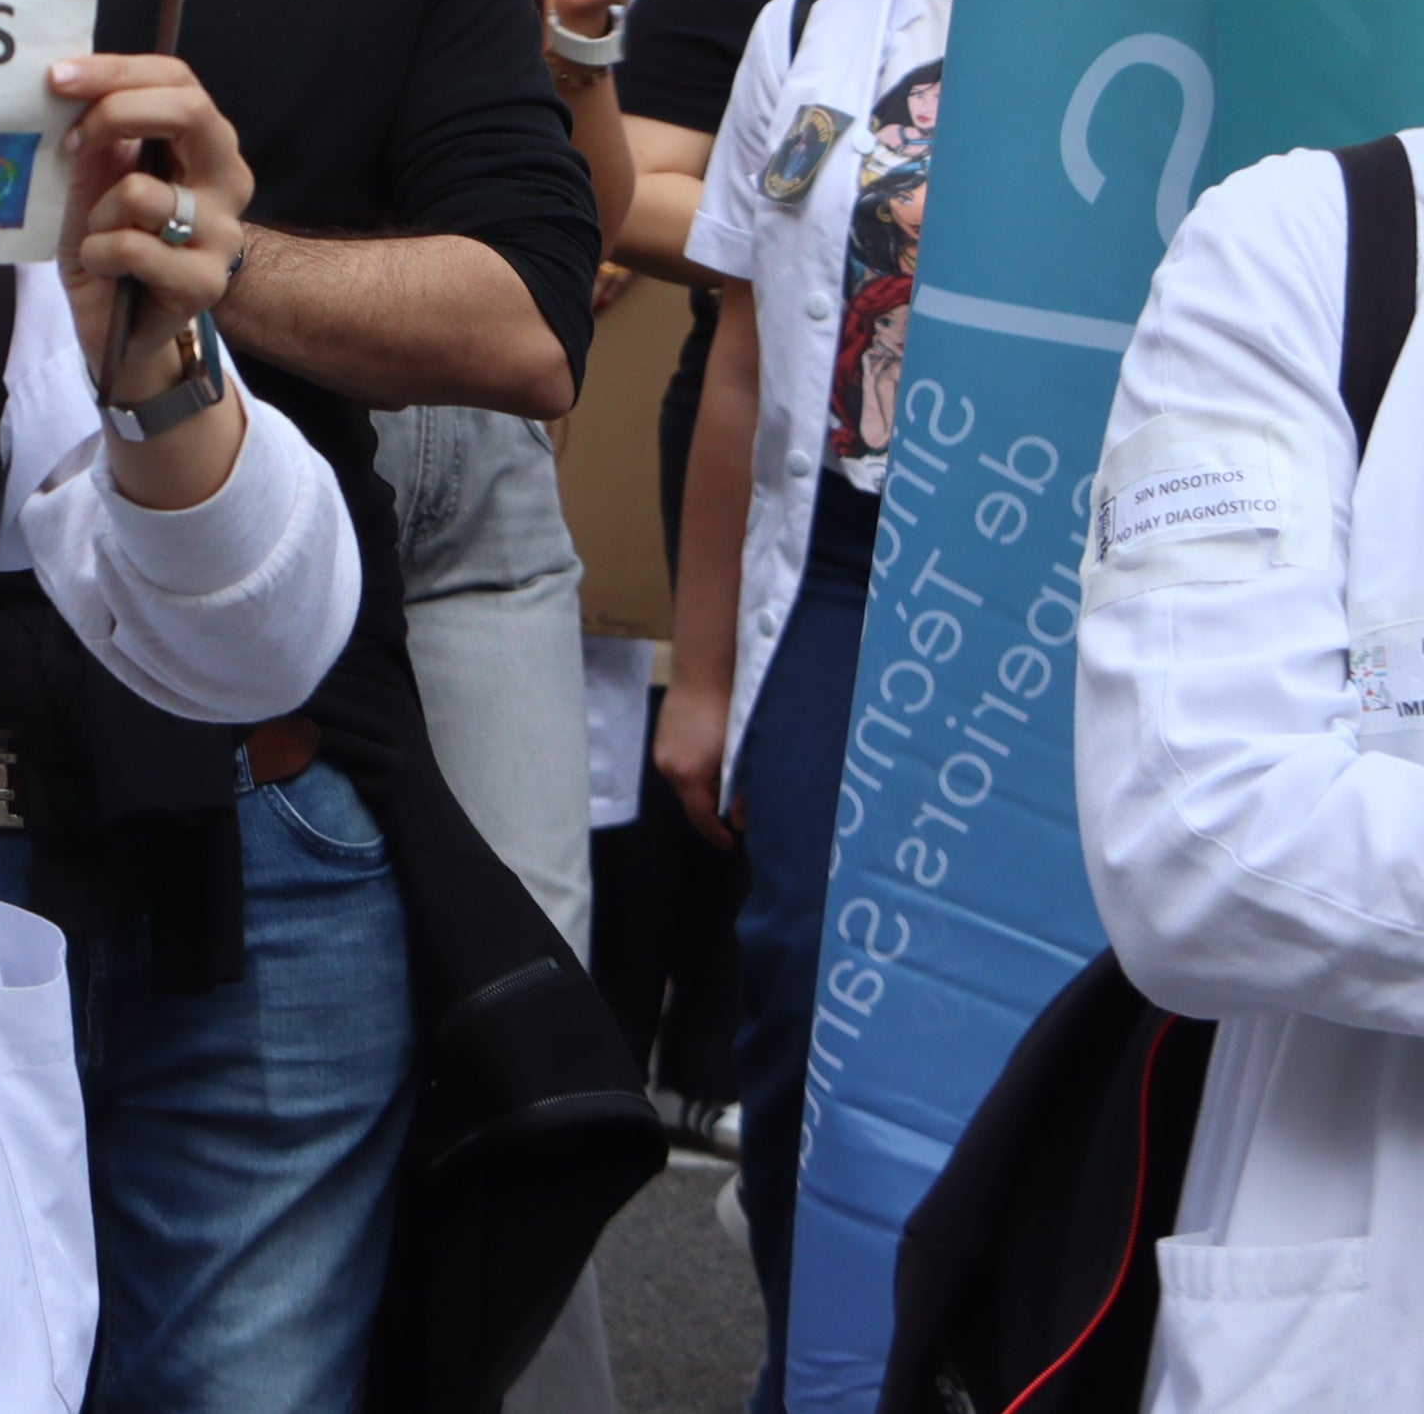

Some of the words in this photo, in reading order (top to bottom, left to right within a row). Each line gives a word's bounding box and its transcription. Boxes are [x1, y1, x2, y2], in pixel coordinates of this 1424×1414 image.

[1135, 485, 1156, 506] SIN
[1158, 470, 1245, 497] NOSOTROS
[1115, 526, 1132, 544] NO
[1134, 514, 1162, 538] HAY
[1165, 499, 1278, 526] DIAGNÓSTICO
